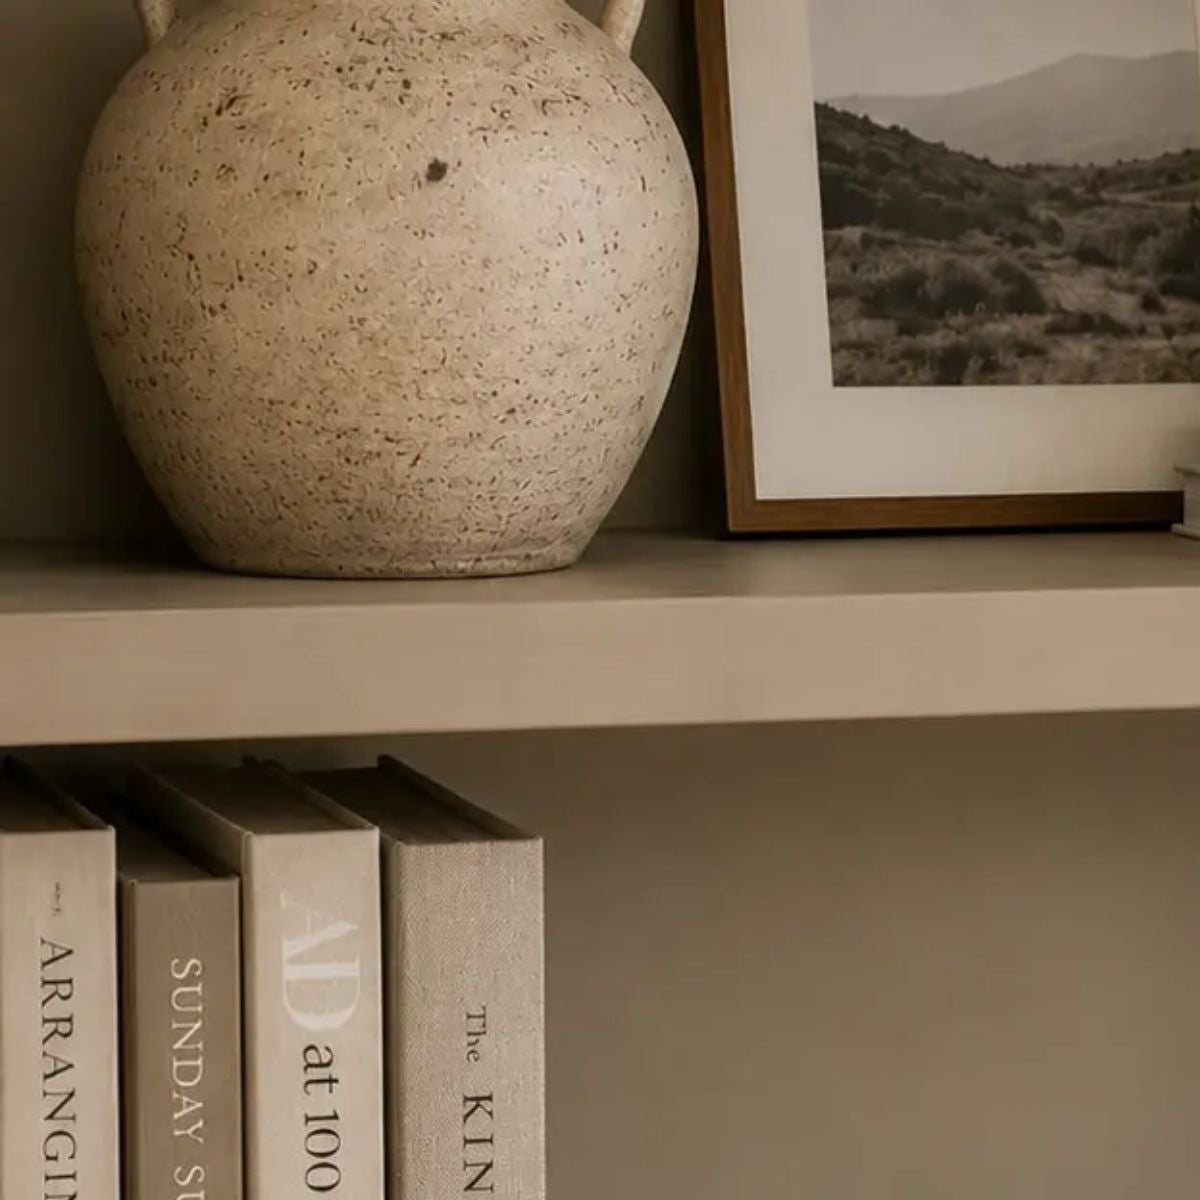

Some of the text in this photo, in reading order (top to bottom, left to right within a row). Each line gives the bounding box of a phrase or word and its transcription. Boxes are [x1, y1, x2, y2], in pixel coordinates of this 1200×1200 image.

[171, 958, 203, 1143] SUNDAY
[281, 893, 360, 1192] AD at 100
[466, 1006, 487, 1062] The
